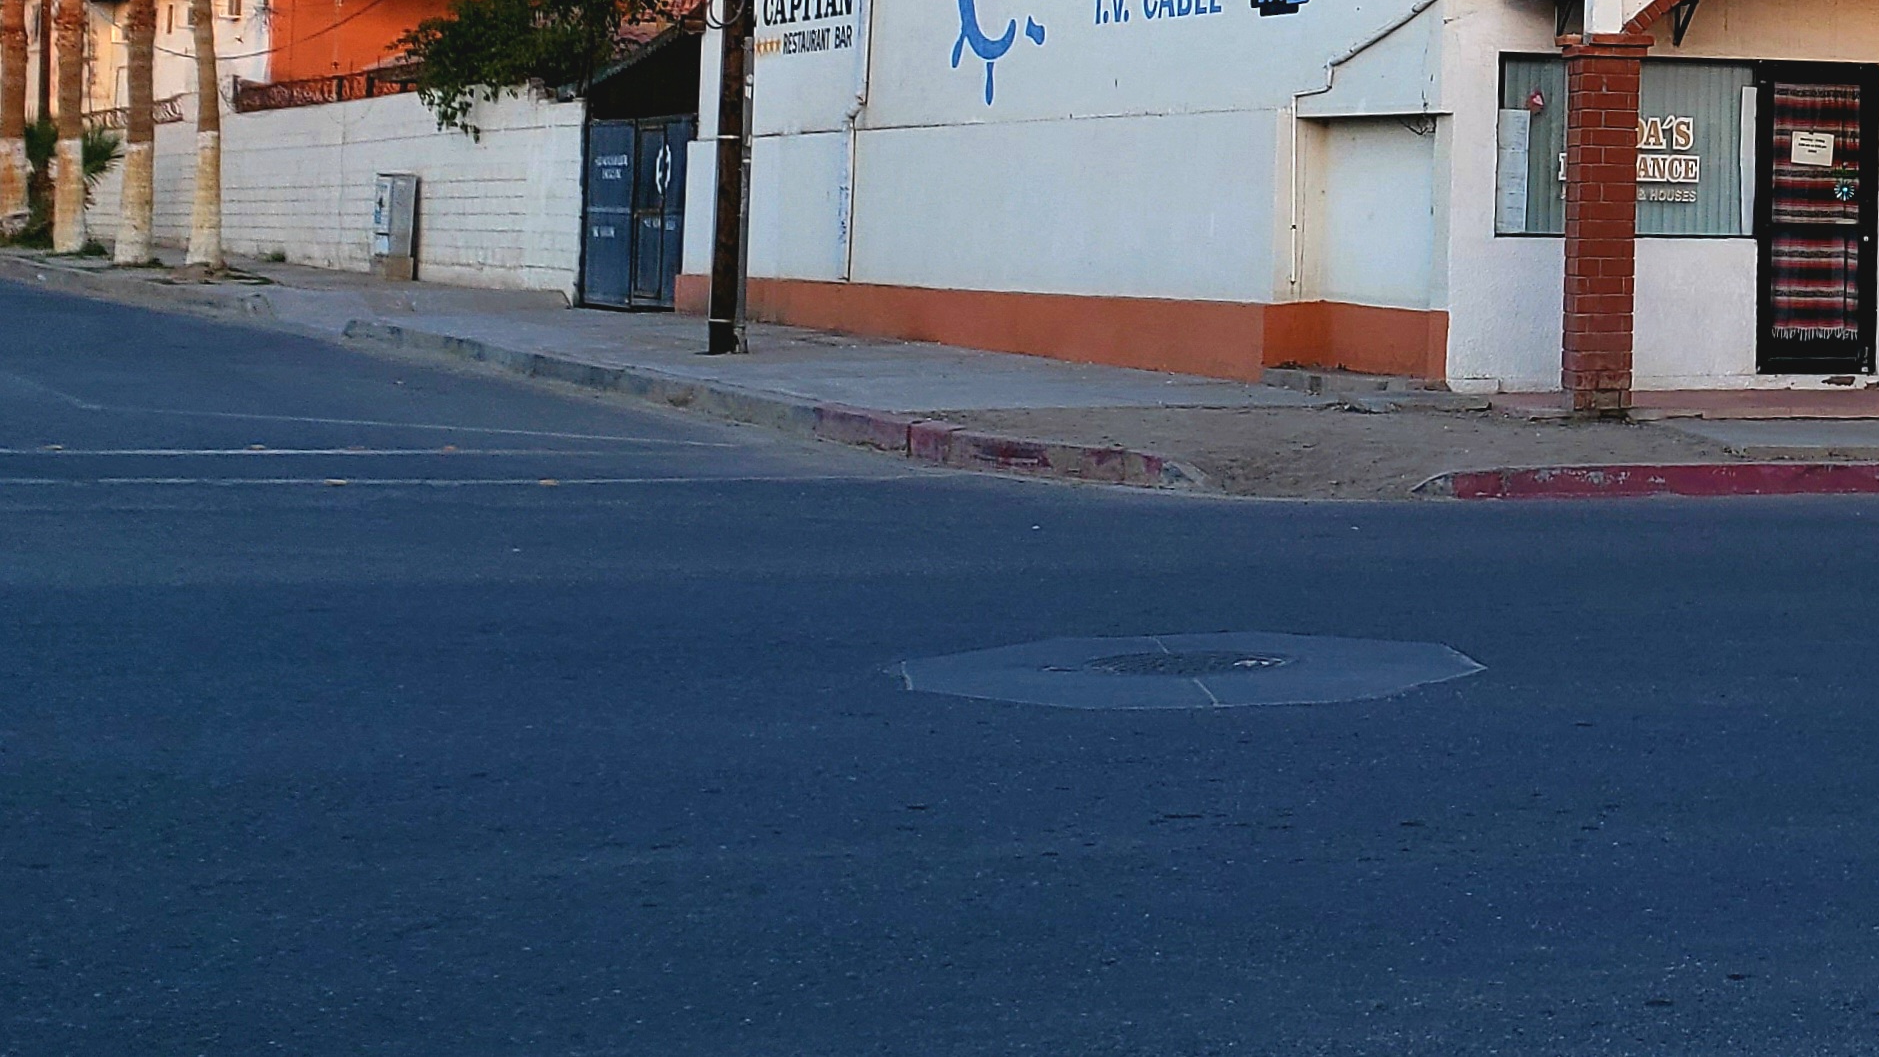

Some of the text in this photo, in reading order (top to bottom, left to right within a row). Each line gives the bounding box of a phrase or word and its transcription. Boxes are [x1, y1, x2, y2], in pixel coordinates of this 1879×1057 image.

[782, 24, 853, 55] RESTAURANT BAR
[1649, 189, 1698, 203] HOUSES
